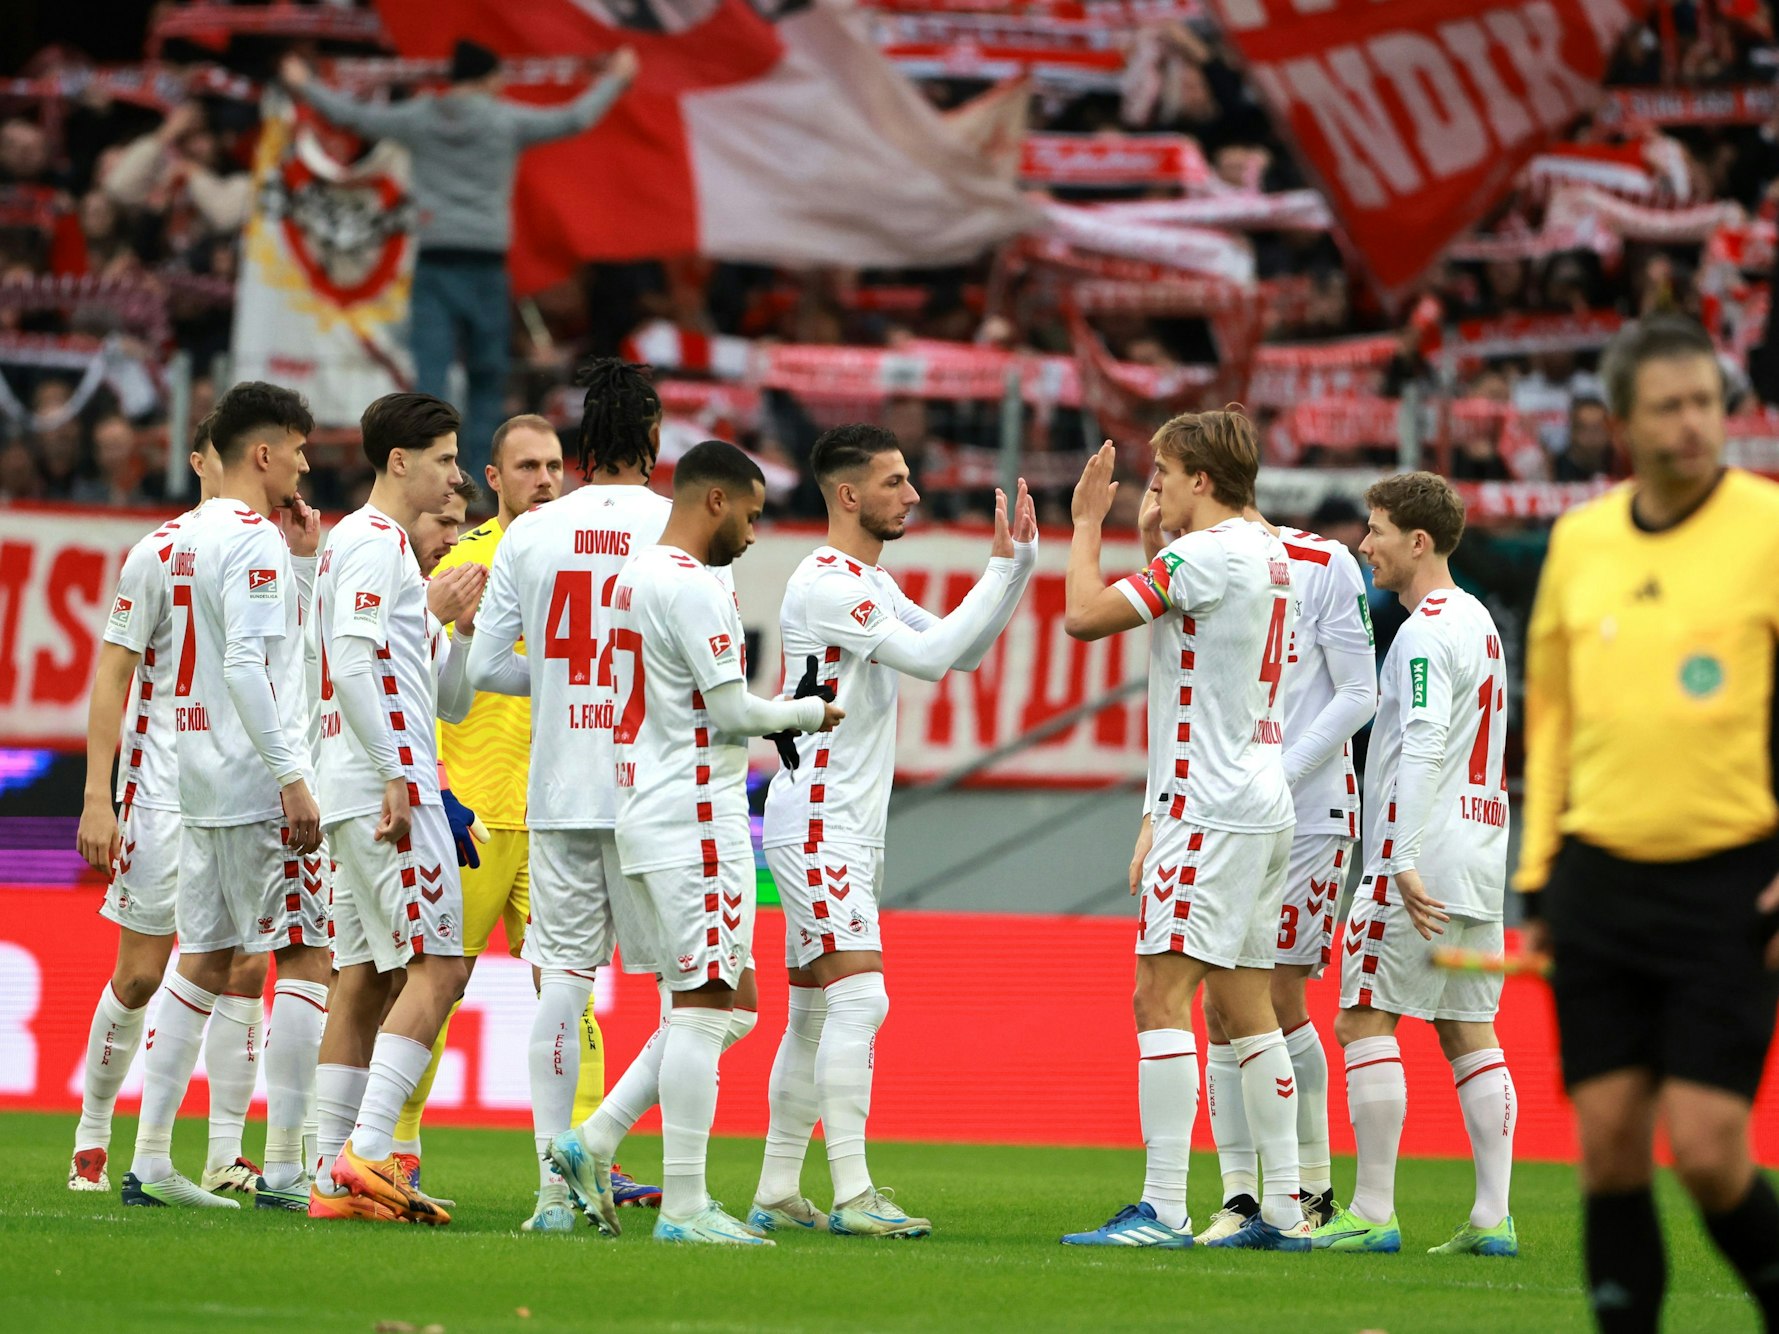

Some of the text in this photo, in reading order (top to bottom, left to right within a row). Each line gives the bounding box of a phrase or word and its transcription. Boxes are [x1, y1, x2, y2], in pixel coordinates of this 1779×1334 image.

[574, 529, 631, 556] DOWNS
[173, 585, 197, 697] 7
[1258, 597, 1287, 708] 4
[1413, 662, 1424, 703] DEVK
[175, 707, 187, 731] FC
[569, 699, 615, 729] 1. FC KÖ
[1460, 795, 1470, 819] 1.
[1471, 796, 1483, 822] FC
[555, 1034, 565, 1048] FC
[1504, 1085, 1511, 1101] FC
